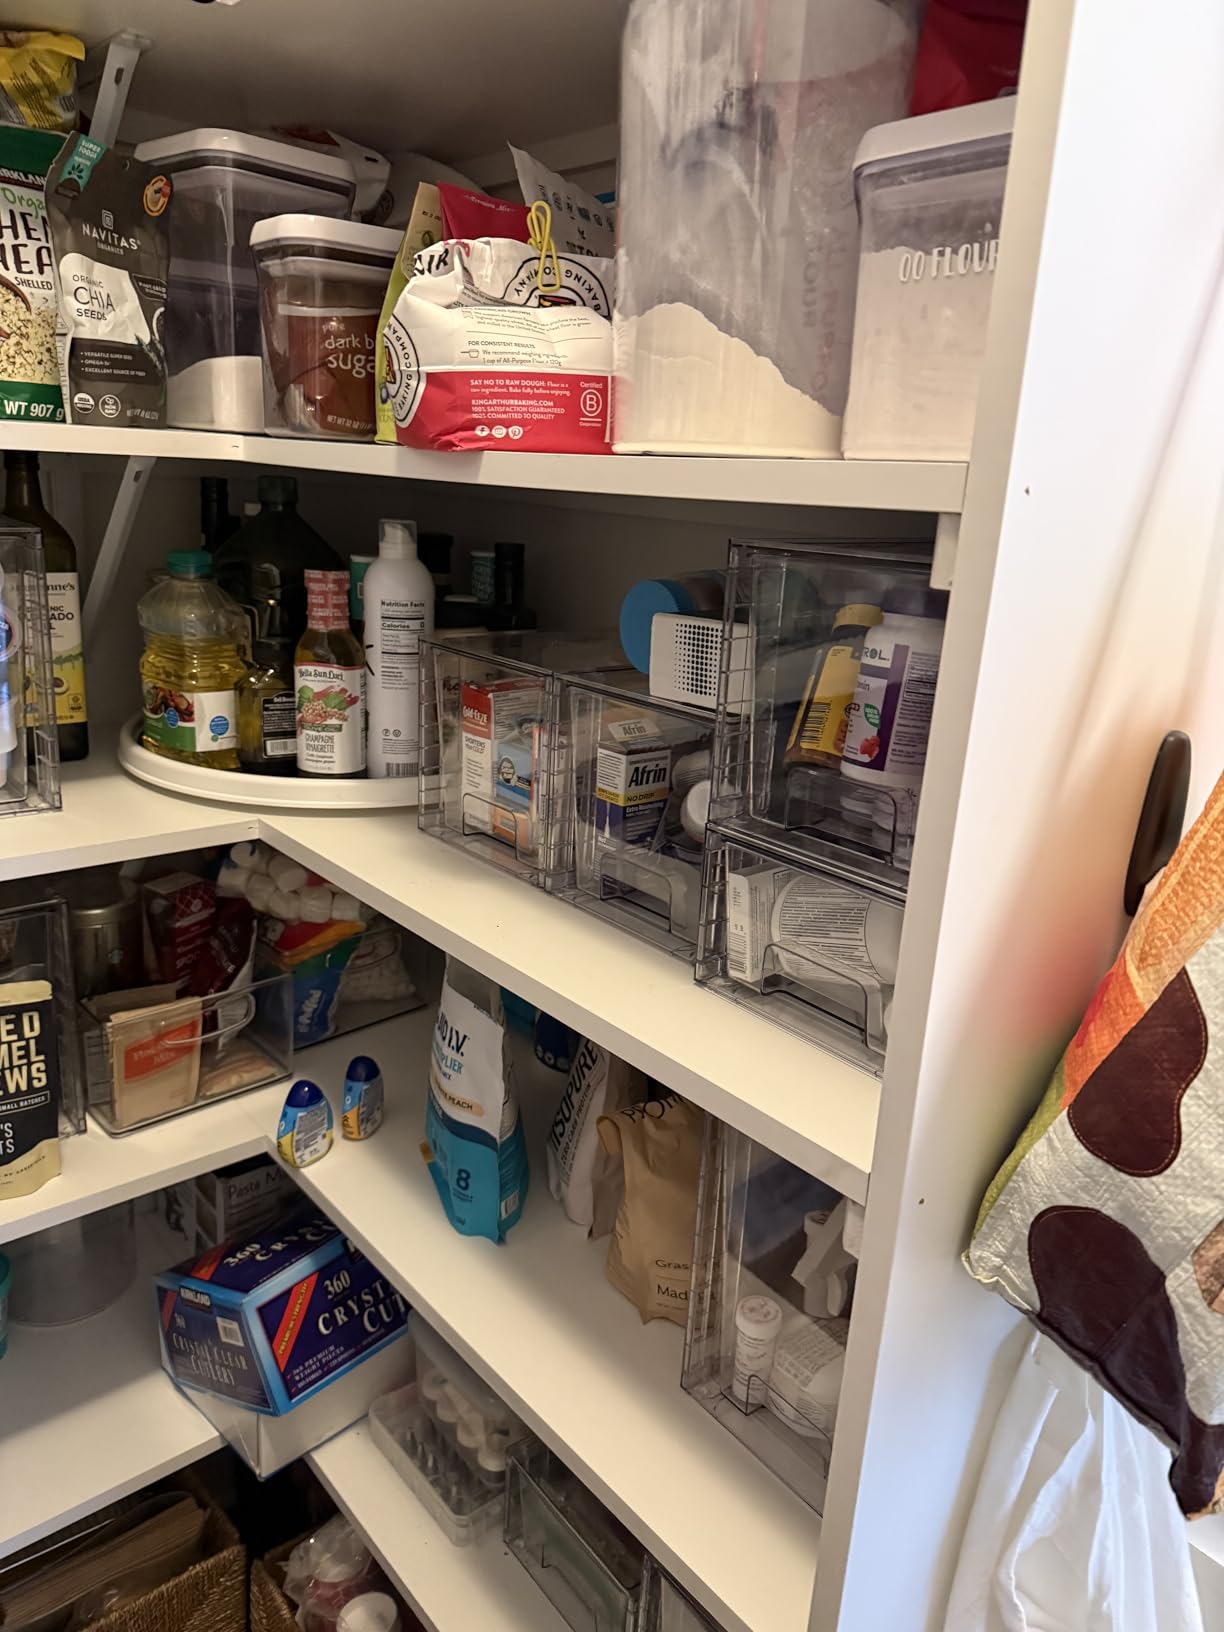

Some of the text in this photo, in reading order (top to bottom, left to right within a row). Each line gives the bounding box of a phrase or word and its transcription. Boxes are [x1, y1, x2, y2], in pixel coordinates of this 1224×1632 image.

[82, 223, 138, 250] NAVITAS
[14, 277, 52, 291] SHELLED
[73, 286, 116, 312] CHIA
[76, 308, 107, 321] SEEDS
[324, 333, 360, 350] dark
[4, 399, 64, 422] WT 907 g
[622, 723, 647, 737] Afrin
[628, 764, 667, 788] Afrin
[0, 1011, 41, 1042] ED
[0, 1061, 48, 1096] WS
[550, 1039, 599, 1152] ISOPURE
[456, 1168, 471, 1191] 8
[324, 1270, 350, 1300] 360
